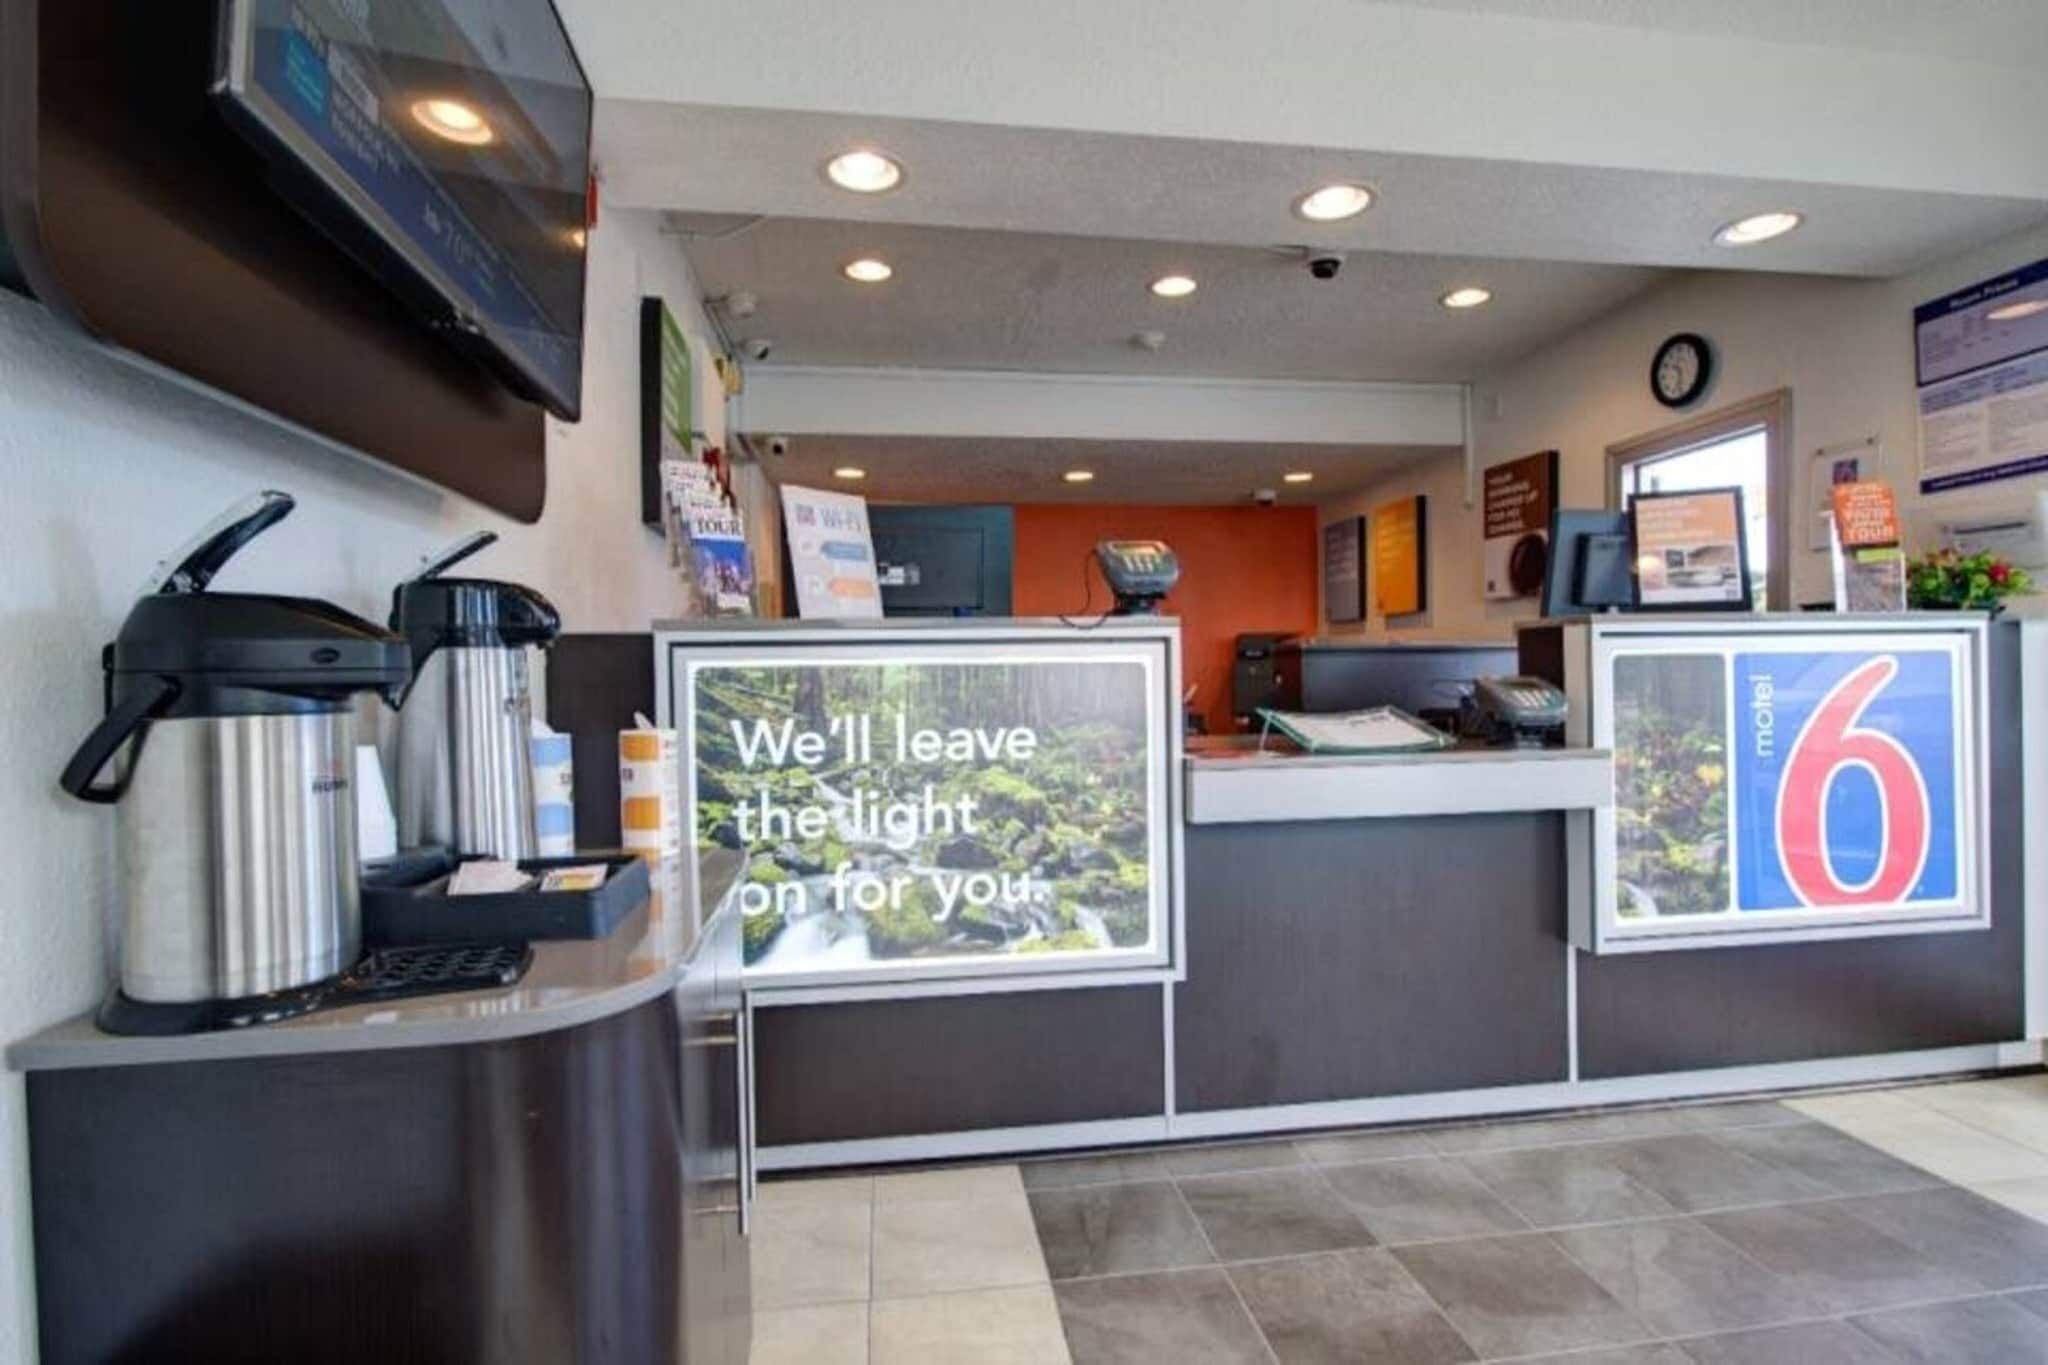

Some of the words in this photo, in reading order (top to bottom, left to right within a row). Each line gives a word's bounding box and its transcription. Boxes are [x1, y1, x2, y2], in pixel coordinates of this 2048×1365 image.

[730, 713, 871, 766] We'll
[896, 711, 1038, 763] leave
[1748, 672, 1774, 758] motel
[1775, 654, 1931, 908] 6
[732, 787, 829, 841] the
[853, 782, 979, 851] light
[739, 880, 808, 916] on
[828, 860, 914, 911] for
[931, 872, 1045, 922] you.
